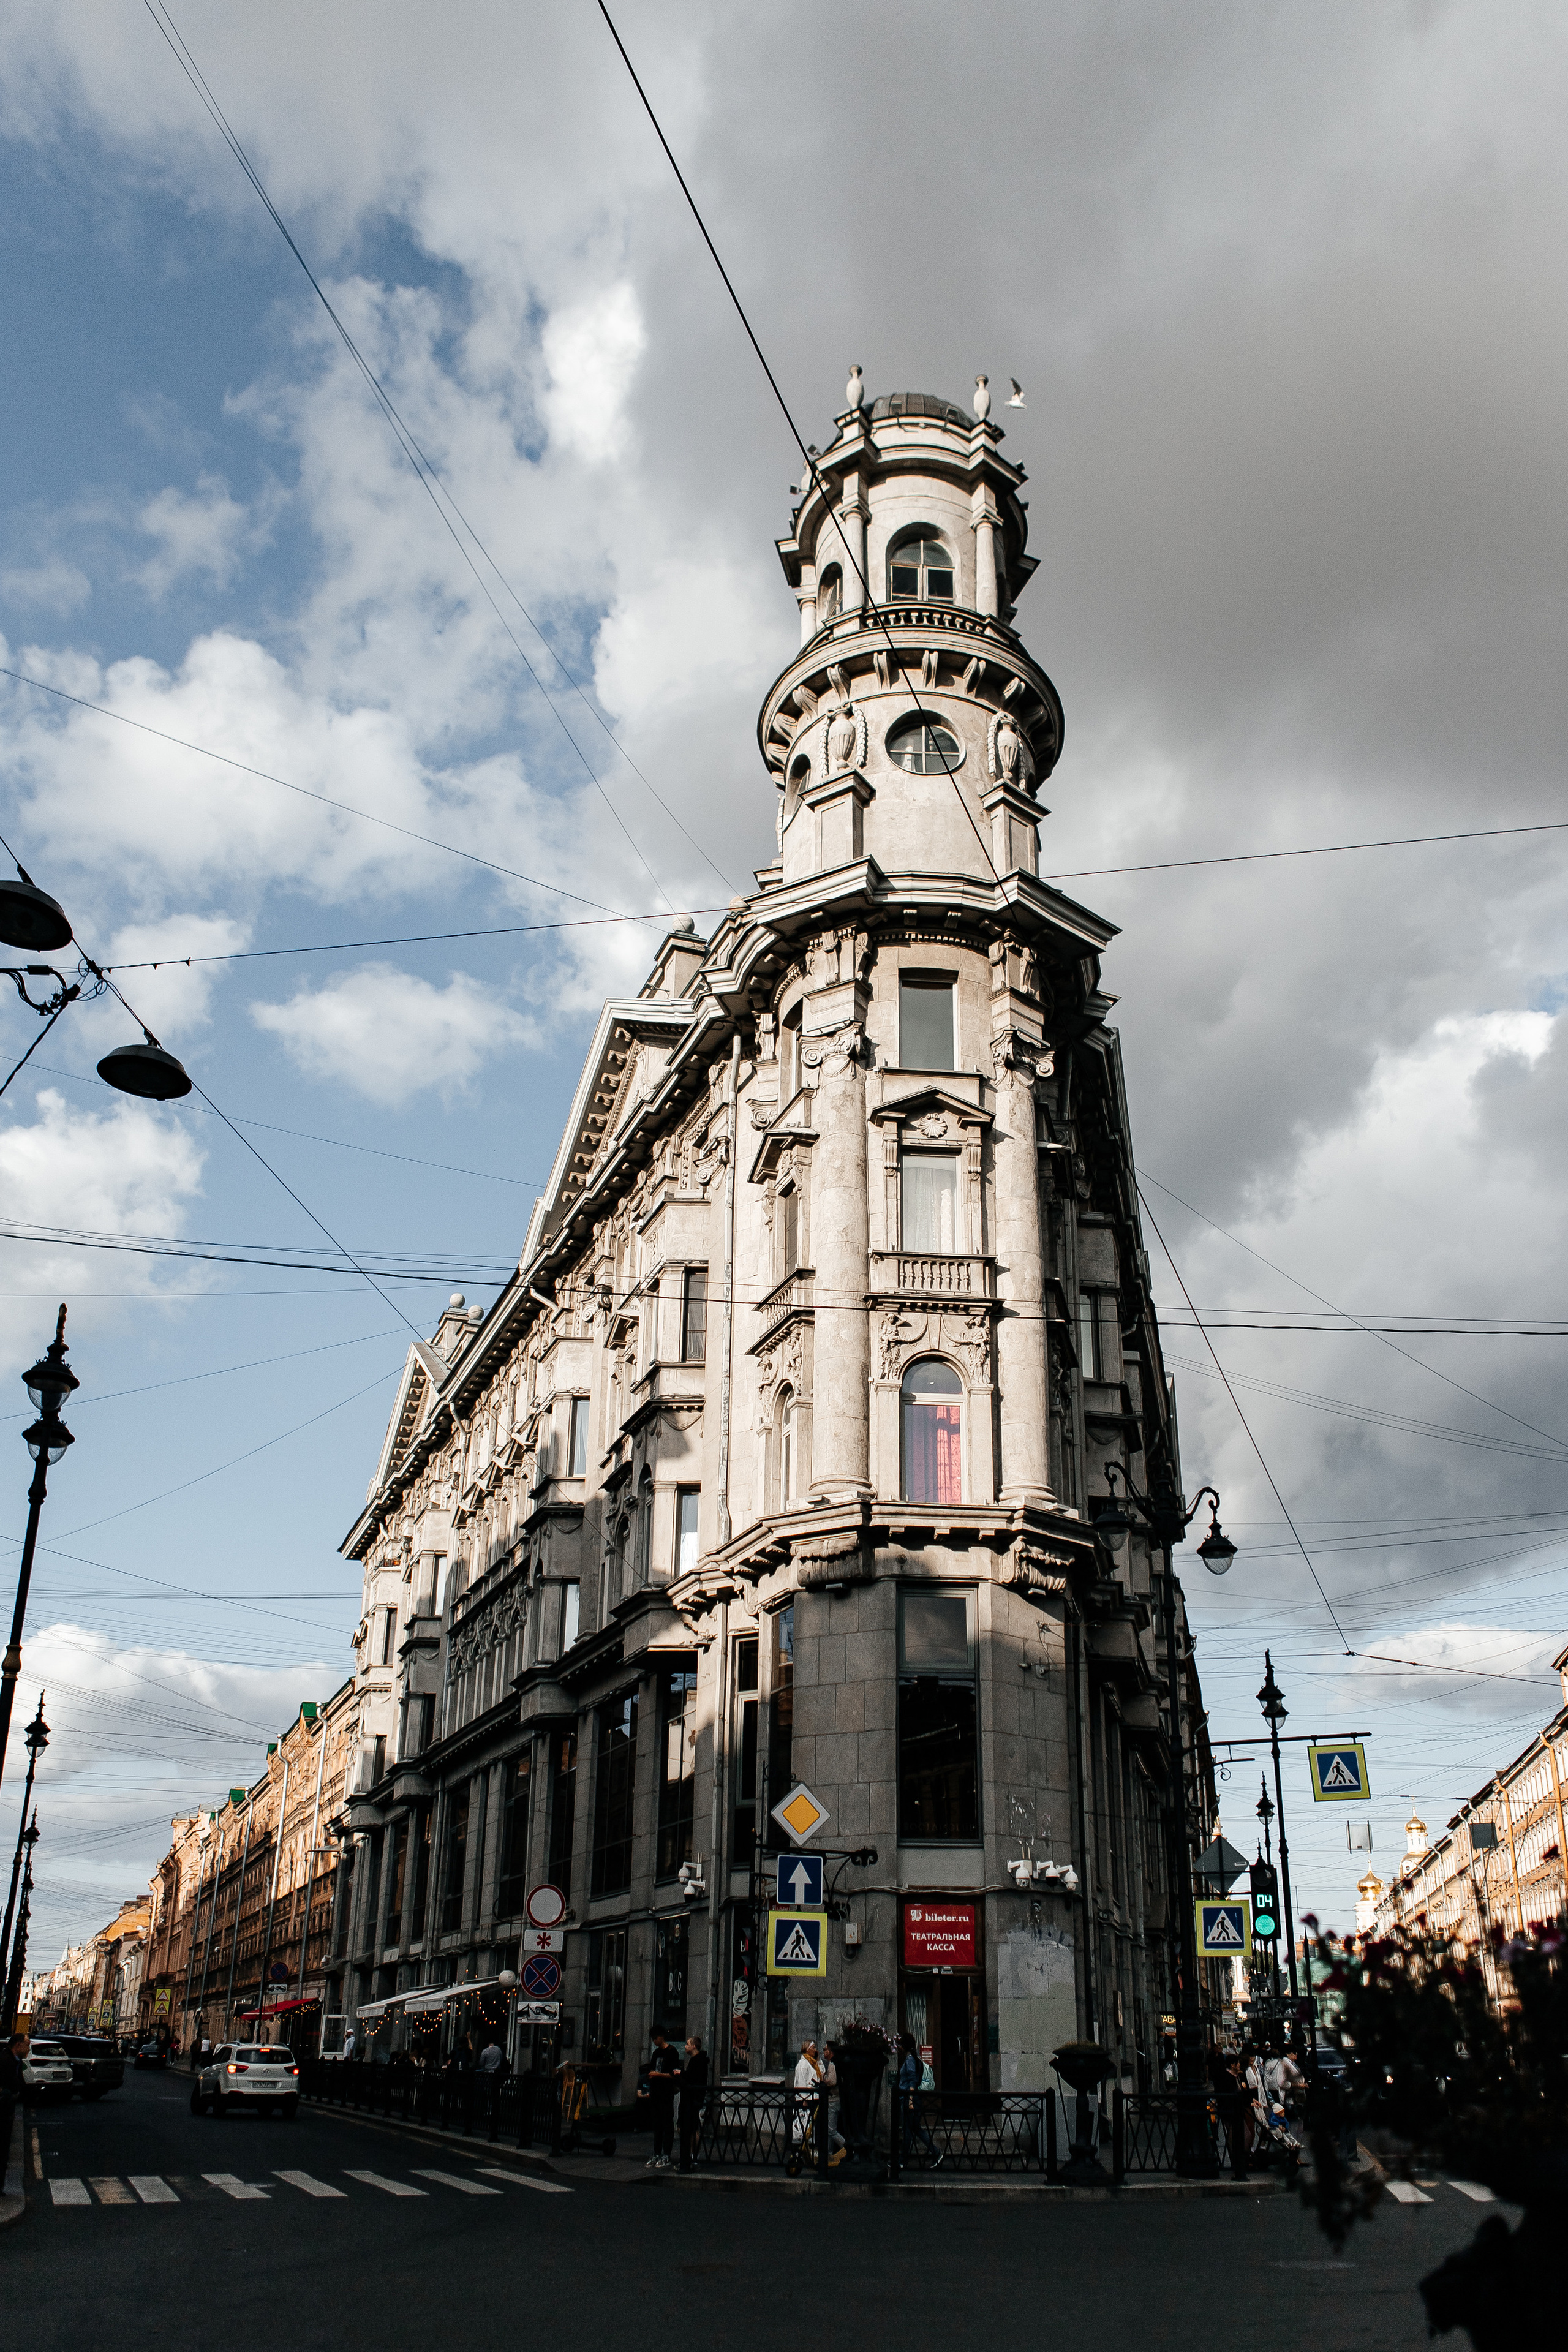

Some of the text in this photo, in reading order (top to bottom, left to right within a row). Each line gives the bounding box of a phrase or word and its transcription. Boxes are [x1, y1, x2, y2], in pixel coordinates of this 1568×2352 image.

[1257, 1894, 1273, 1908] 04
[925, 1913, 970, 1922] bileter.ru
[911, 1932, 971, 1941] ТЕАТРАЛЬНАЯ
[1161, 2015, 1183, 2024] АБА
